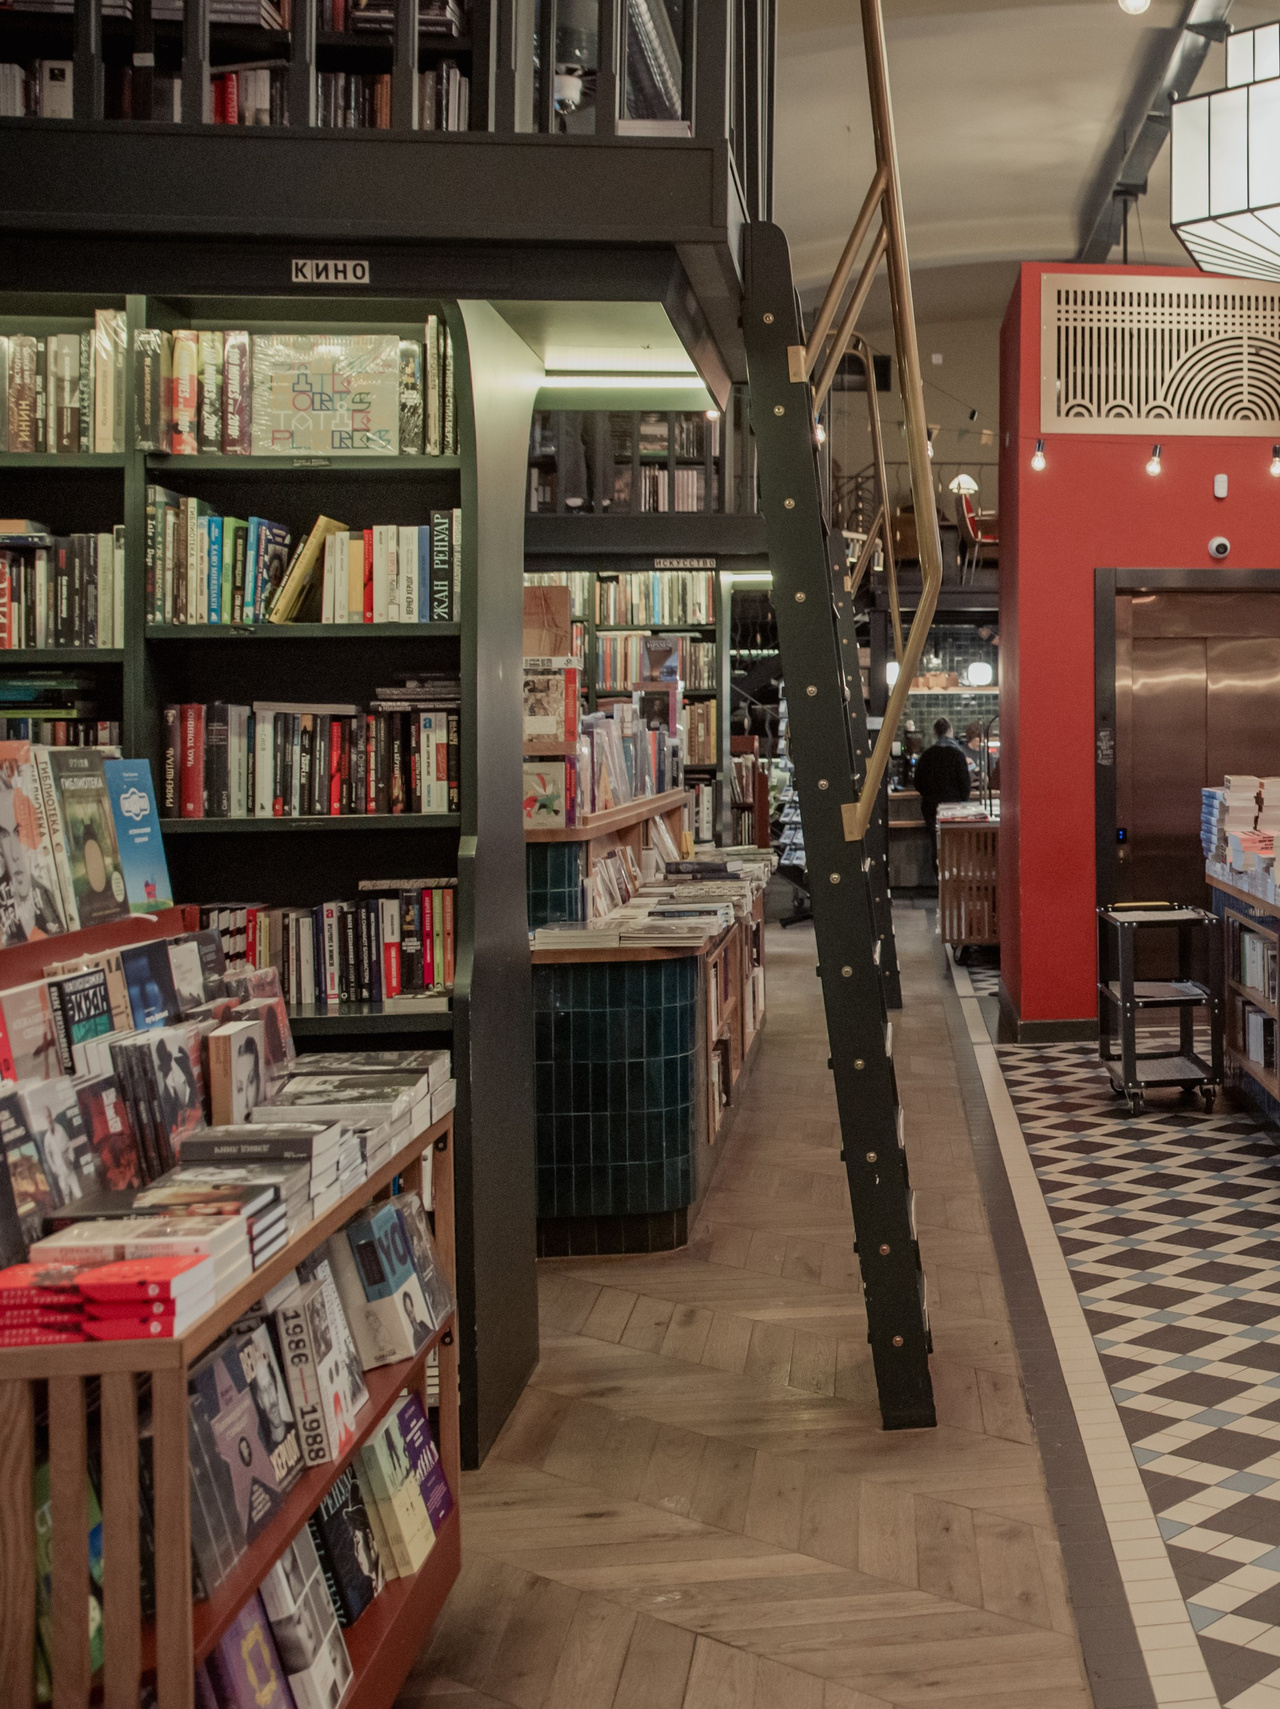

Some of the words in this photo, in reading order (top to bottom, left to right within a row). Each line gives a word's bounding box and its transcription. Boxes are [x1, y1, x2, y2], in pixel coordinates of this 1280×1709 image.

[294, 261, 368, 282] КИНО
[204, 364, 217, 398] MOVIES
[228, 365, 240, 399] MOVIES
[18, 401, 31, 442] ИНИН
[188, 506, 196, 558] ГИБЛИОТЕКА
[433, 514, 450, 569] РЕНУАР
[146, 548, 155, 566] Dogs
[655, 559, 716, 568] ИСКУССТВО
[210, 567, 218, 608] МИЯДЗАКИ
[406, 575, 414, 595] ХЕРЦОГ
[433, 580, 449, 620] ЖАН
[406, 596, 414, 615] ВЕРНЕР
[61, 777, 104, 790] ГИБЛИОТЕКА
[165, 747, 175, 807] РИФЕНШТАЛЬ
[38, 760, 60, 837] ГИБЛИОТЕКА
[68, 985, 109, 1022] ЭКРАН
[282, 1309, 309, 1368] 1986
[299, 1405, 326, 1462] 1988
